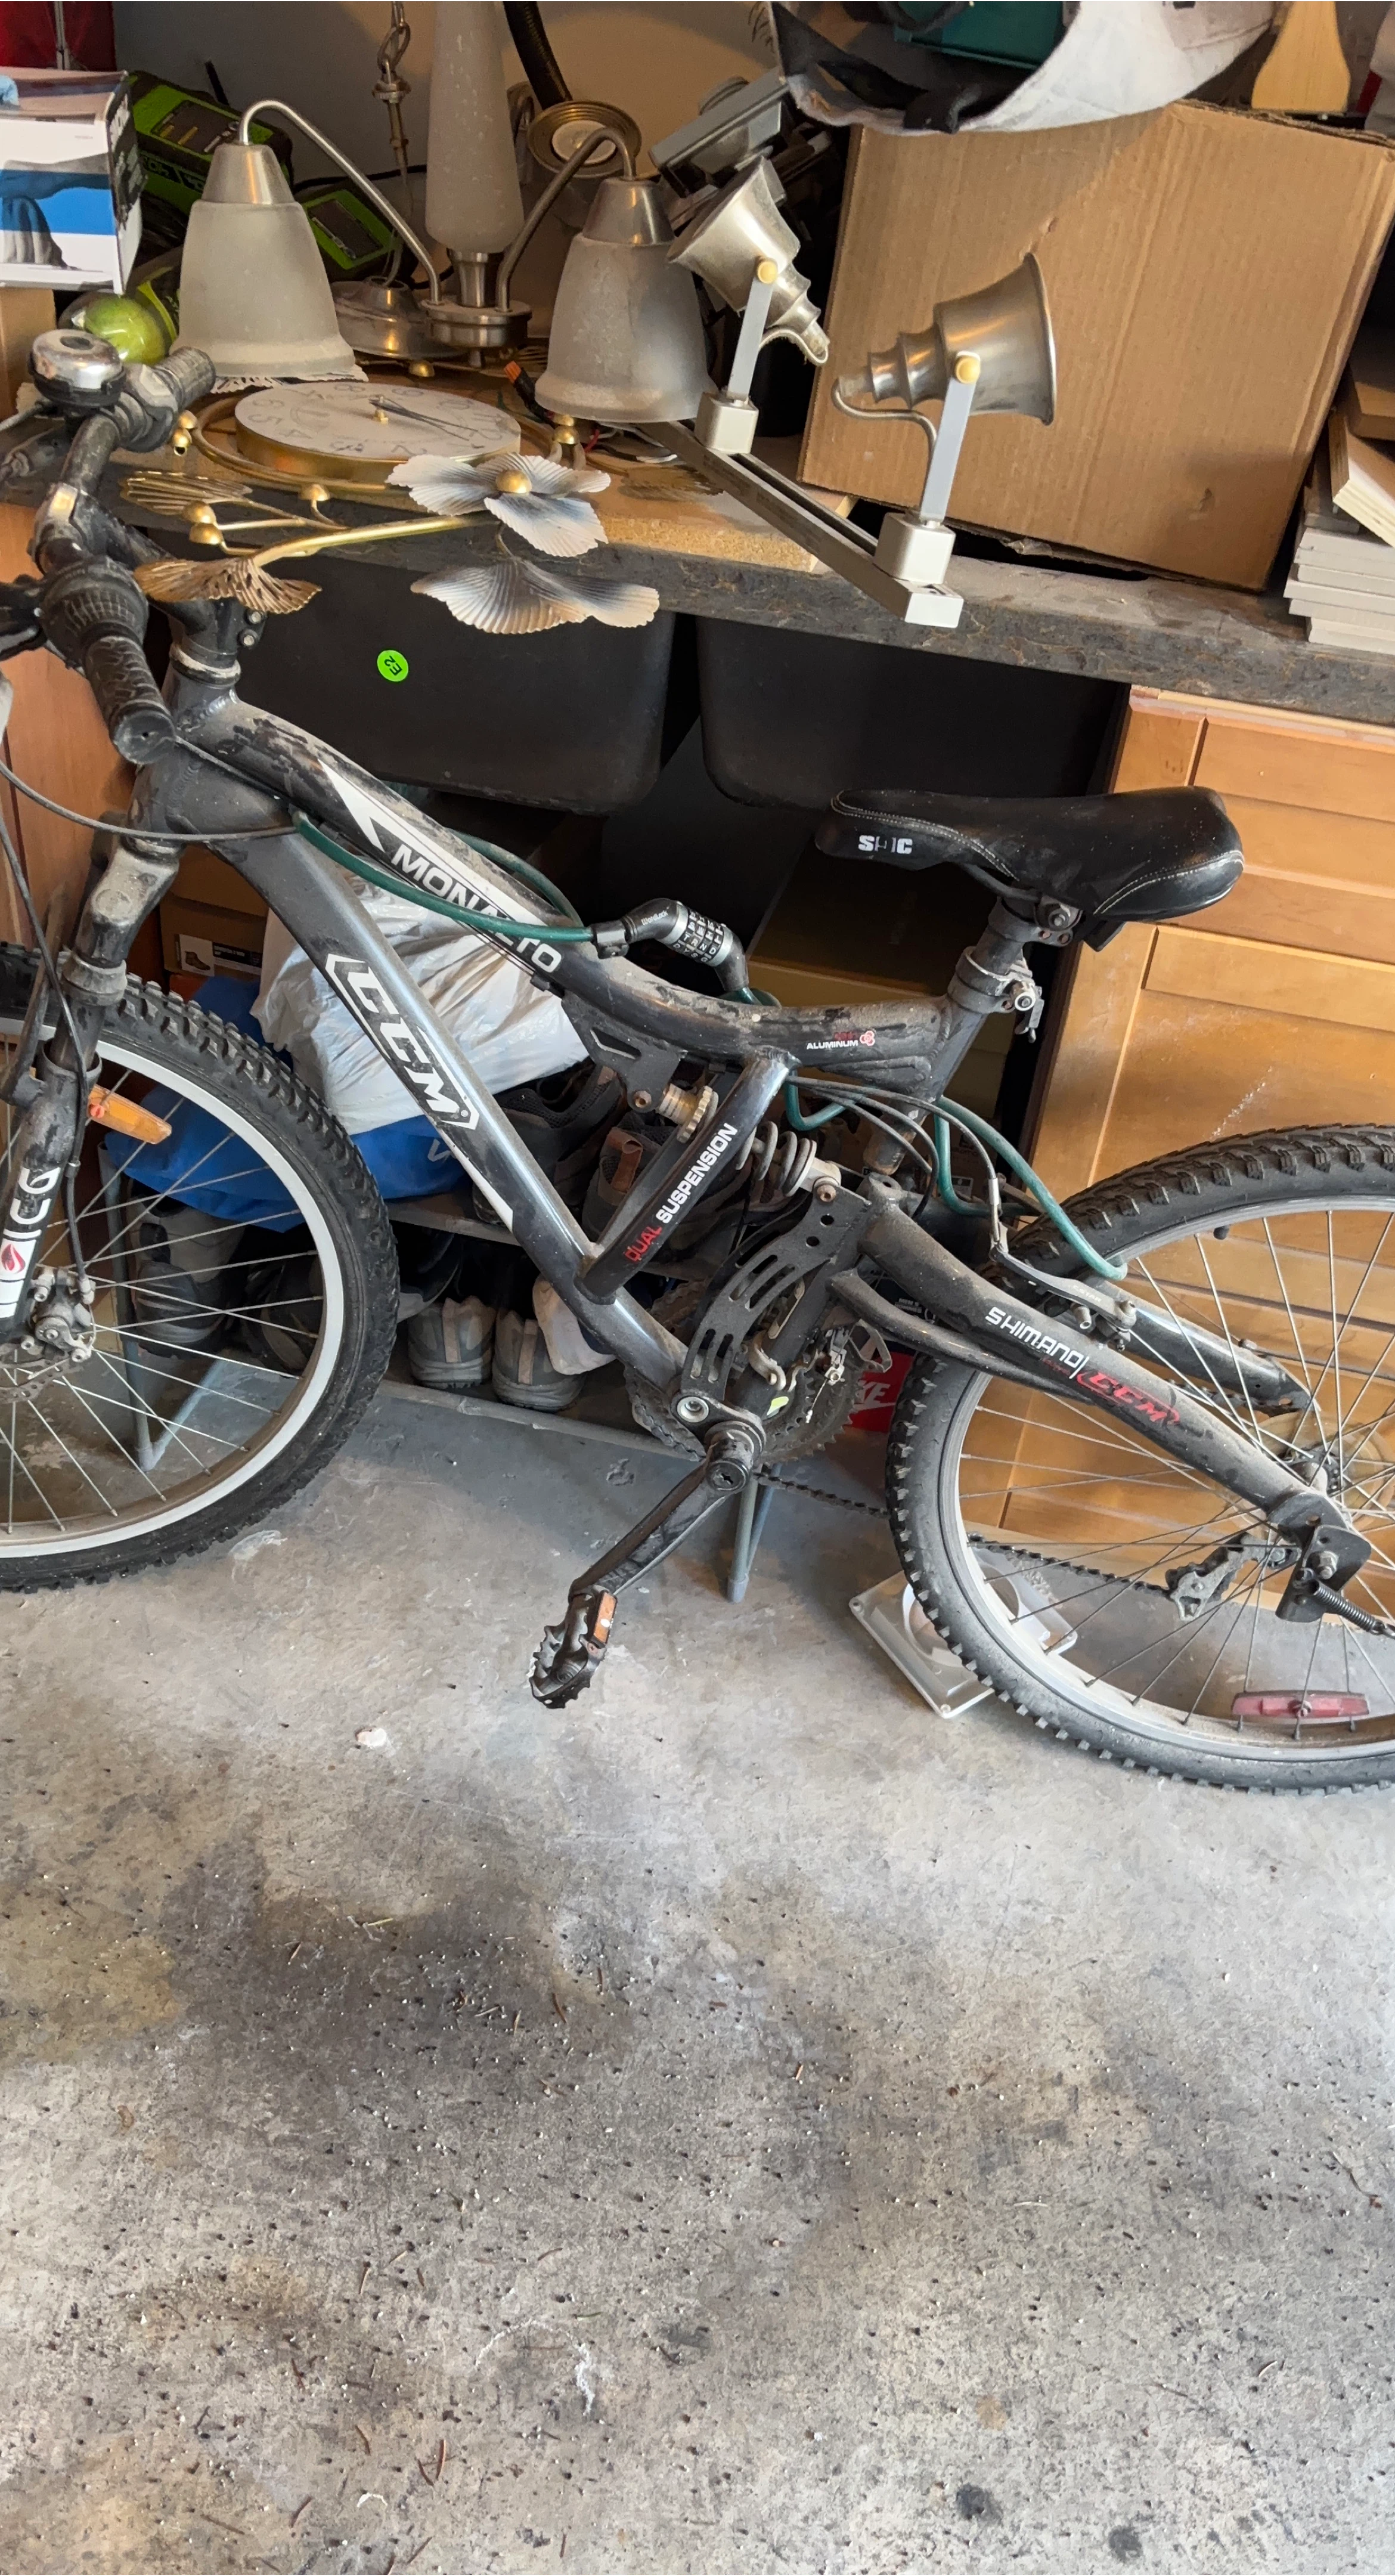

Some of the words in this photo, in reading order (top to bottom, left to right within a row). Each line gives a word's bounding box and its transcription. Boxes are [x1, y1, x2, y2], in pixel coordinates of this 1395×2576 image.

[384, 655, 403, 676] E2
[346, 965, 461, 1114] CCM
[806, 1039, 859, 1050] ALUMINUM
[624, 1225, 664, 1262] DUAL
[655, 1122, 738, 1224] SUSPENSION
[984, 1306, 1084, 1369] SHIMANO
[1089, 1371, 1168, 1422] CCM
